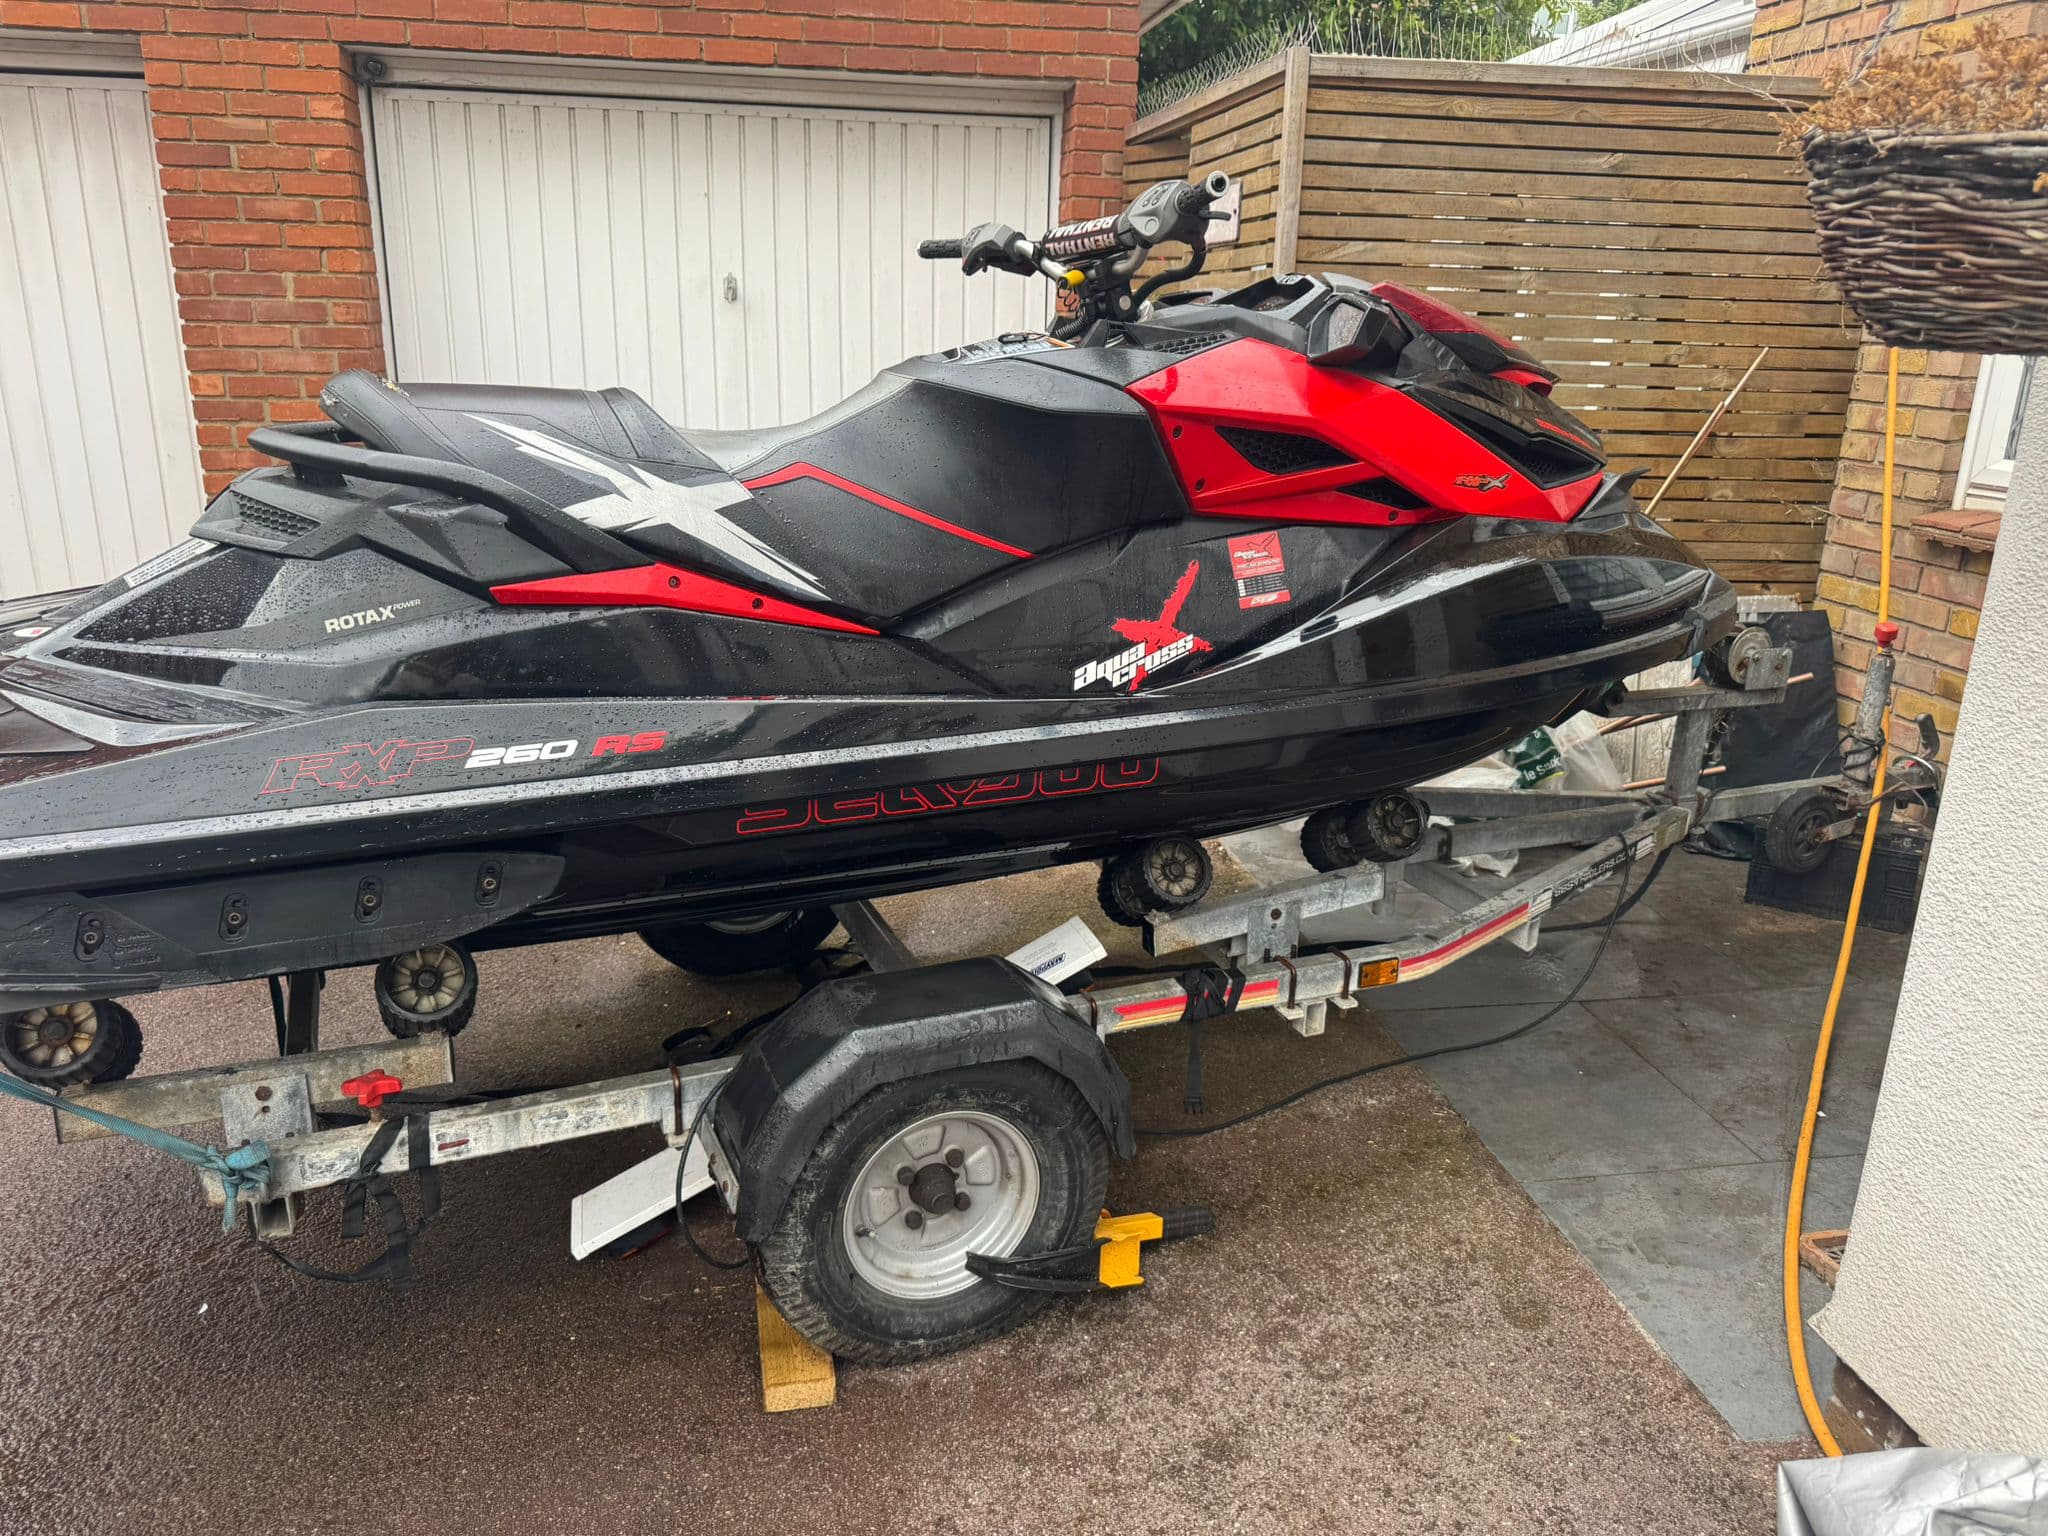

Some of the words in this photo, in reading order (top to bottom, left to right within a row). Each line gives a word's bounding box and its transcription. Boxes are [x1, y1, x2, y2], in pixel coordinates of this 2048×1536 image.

[1048, 214, 1119, 239] RENTHAL
[1045, 232, 1116, 256] RENTHAL
[324, 605, 395, 633] ROTAX
[393, 599, 421, 611] POWER
[261, 738, 475, 794] RXP
[464, 739, 579, 769] 260
[592, 731, 668, 757] RS
